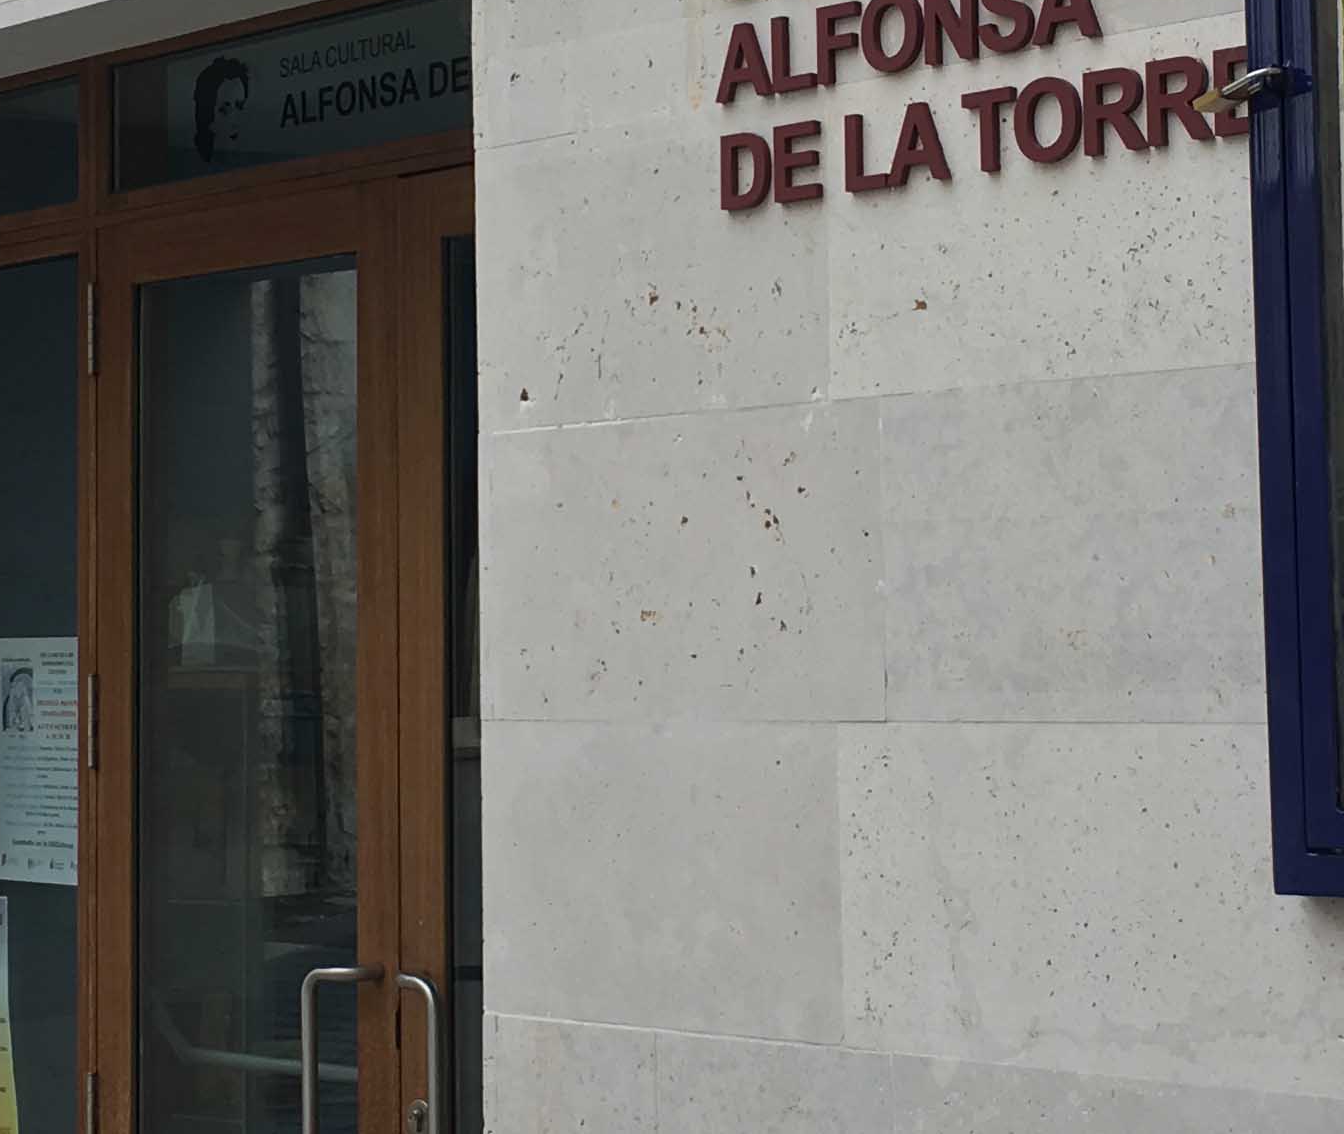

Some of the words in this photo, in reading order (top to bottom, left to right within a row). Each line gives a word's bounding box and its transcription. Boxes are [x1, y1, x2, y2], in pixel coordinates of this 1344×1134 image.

[280, 50, 321, 78] SALA
[326, 28, 416, 68] CULTURAL
[280, 68, 420, 128] ALFONSA
[428, 56, 471, 99] DE
[720, 119, 823, 211] DE
[845, 101, 951, 193] LA
